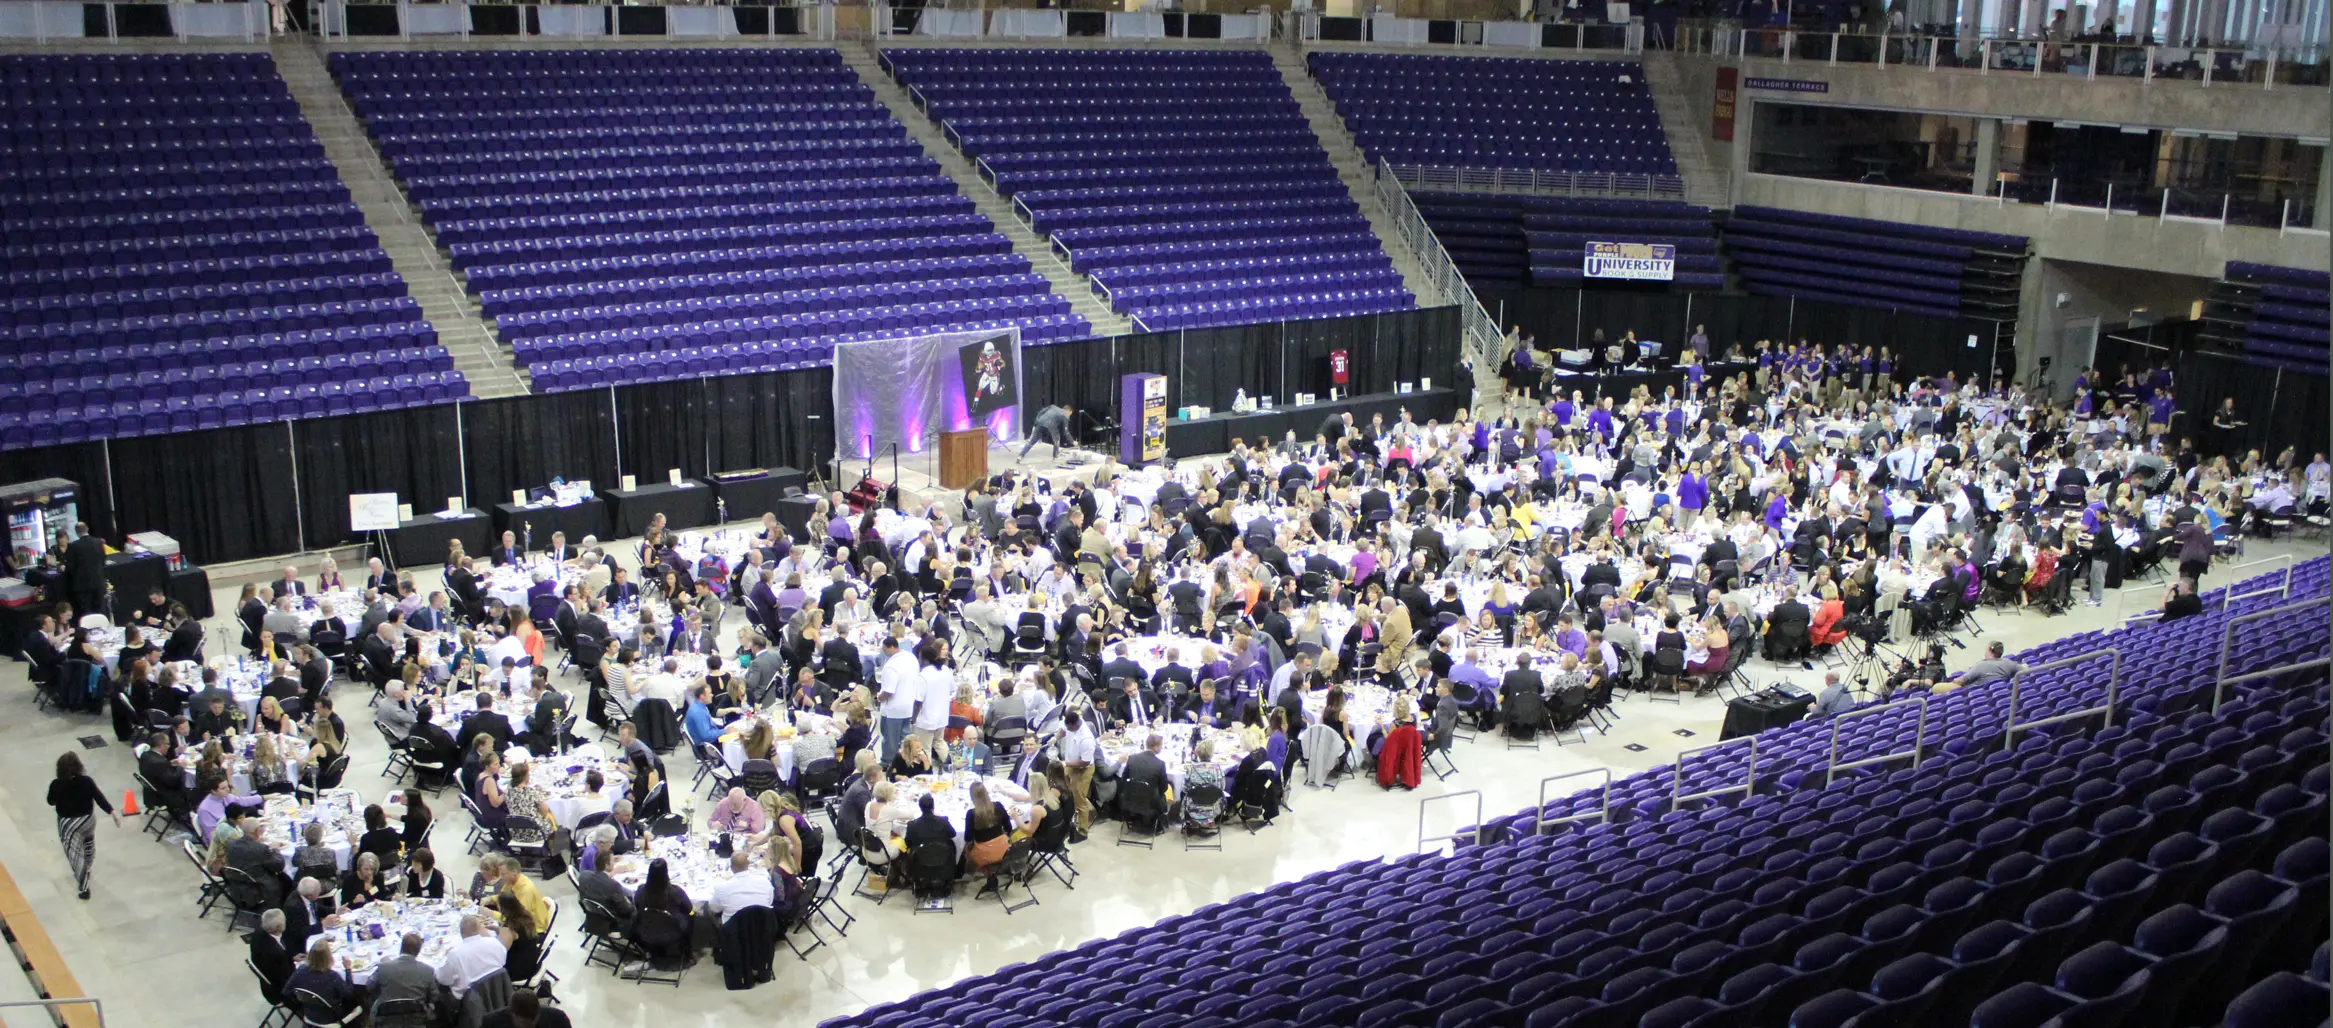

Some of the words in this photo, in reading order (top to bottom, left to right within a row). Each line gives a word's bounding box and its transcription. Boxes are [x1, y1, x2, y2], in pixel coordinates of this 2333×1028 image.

[1747, 79, 1789, 88] GALLAGHER
[1792, 82, 1825, 91] TERRACE
[1594, 244, 1619, 252] Get
[1588, 258, 1671, 275] UNIVERSITY
[984, 362, 992, 371] 31
[1336, 360, 1344, 372] 31
